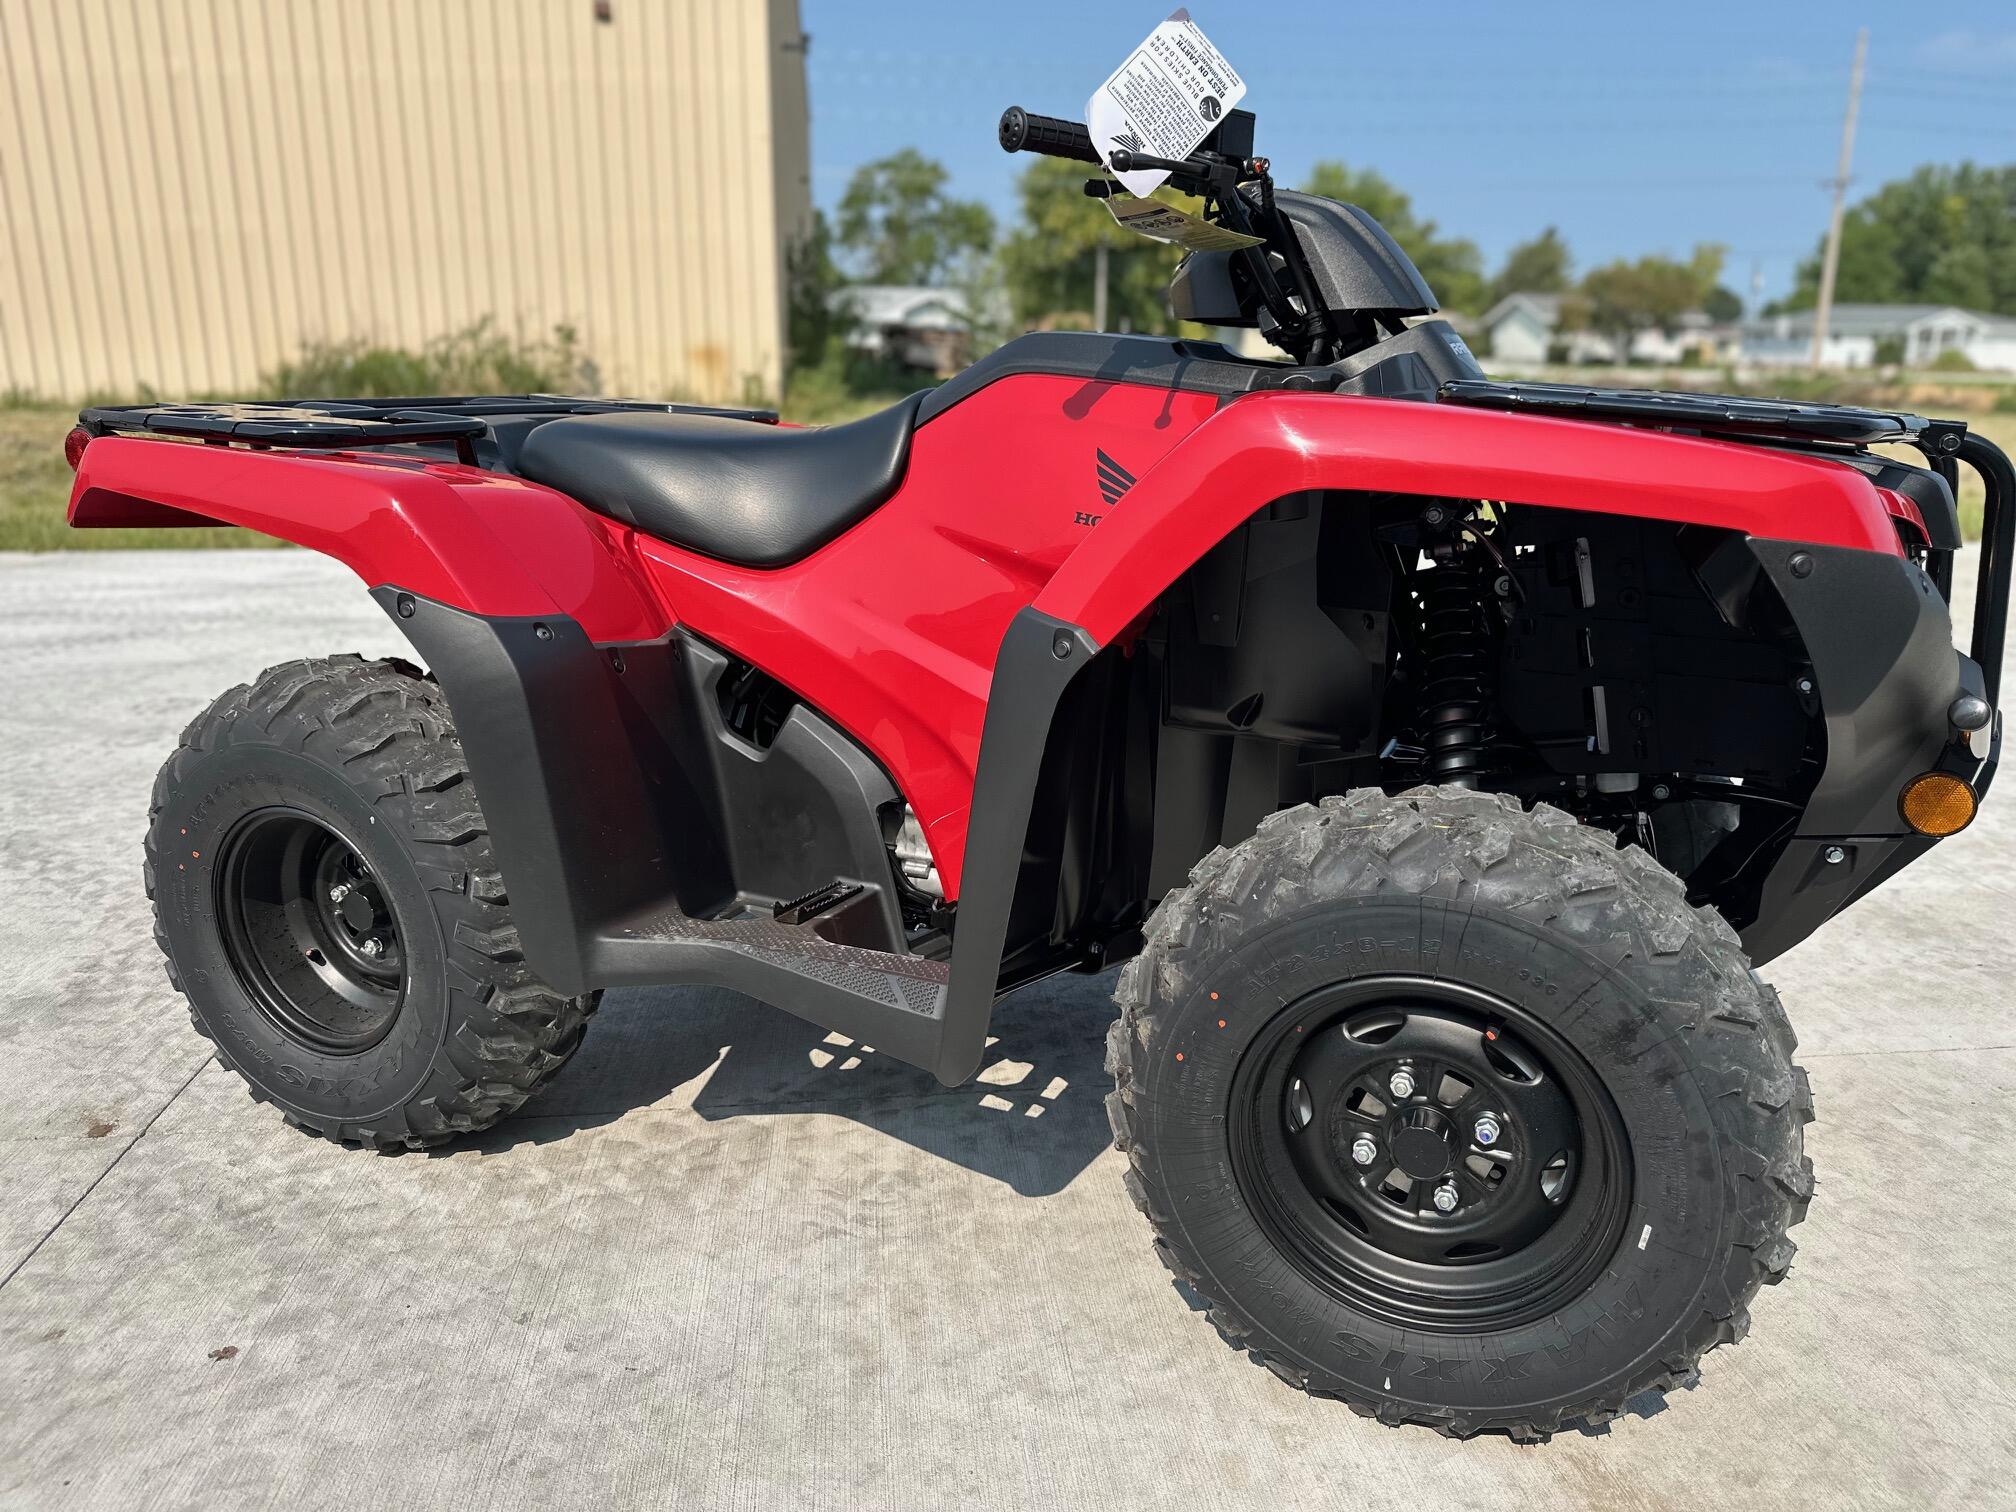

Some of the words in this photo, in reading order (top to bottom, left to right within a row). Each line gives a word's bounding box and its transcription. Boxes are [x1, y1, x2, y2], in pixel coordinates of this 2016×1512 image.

[1149, 40, 1164, 56] FOR
[1154, 33, 1190, 75] CHILDREN
[1140, 60, 1164, 88] performance
[1162, 55, 1183, 79] SKIES
[1195, 52, 1229, 90] PERFORMANCE
[1197, 64, 1209, 77] ON
[1126, 68, 1151, 98] low-emission
[1136, 73, 1145, 83] and
[1189, 74, 1205, 92] OUR
[1123, 82, 1139, 101] position
[1144, 82, 1159, 100] current
[1181, 78, 1200, 99] BLUE
[1206, 77, 1226, 98] BEST
[1111, 84, 1135, 113] performance
[1125, 93, 1134, 103] why
[1149, 97, 1164, 115] develop
[1158, 100, 1166, 108] our
[1167, 94, 1176, 104] kind
[1179, 100, 1187, 109] can
[1132, 102, 1145, 117] that's
[1137, 101, 1158, 125] leadership
[1163, 98, 1186, 125] powersports
[1164, 108, 1172, 116] for
[1174, 104, 1182, 113] the
[1137, 118, 1152, 135] believe
[1144, 117, 1152, 126] and
[1160, 120, 1172, 134] comes
[1186, 109, 1205, 131] everybody
[1123, 119, 1147, 149] HONDA
[1159, 127, 1173, 143] taking
[1167, 121, 1184, 140] continue
[1169, 115, 1194, 144] technologies
[1184, 125, 1196, 140] future
[1192, 127, 1200, 135] And
[1170, 142, 1182, 156] we're
[1175, 140, 1185, 152] when
[1182, 140, 1189, 148] We
[1169, 151, 1177, 159] and
[1328, 1280, 1646, 1384] MAXXIS
